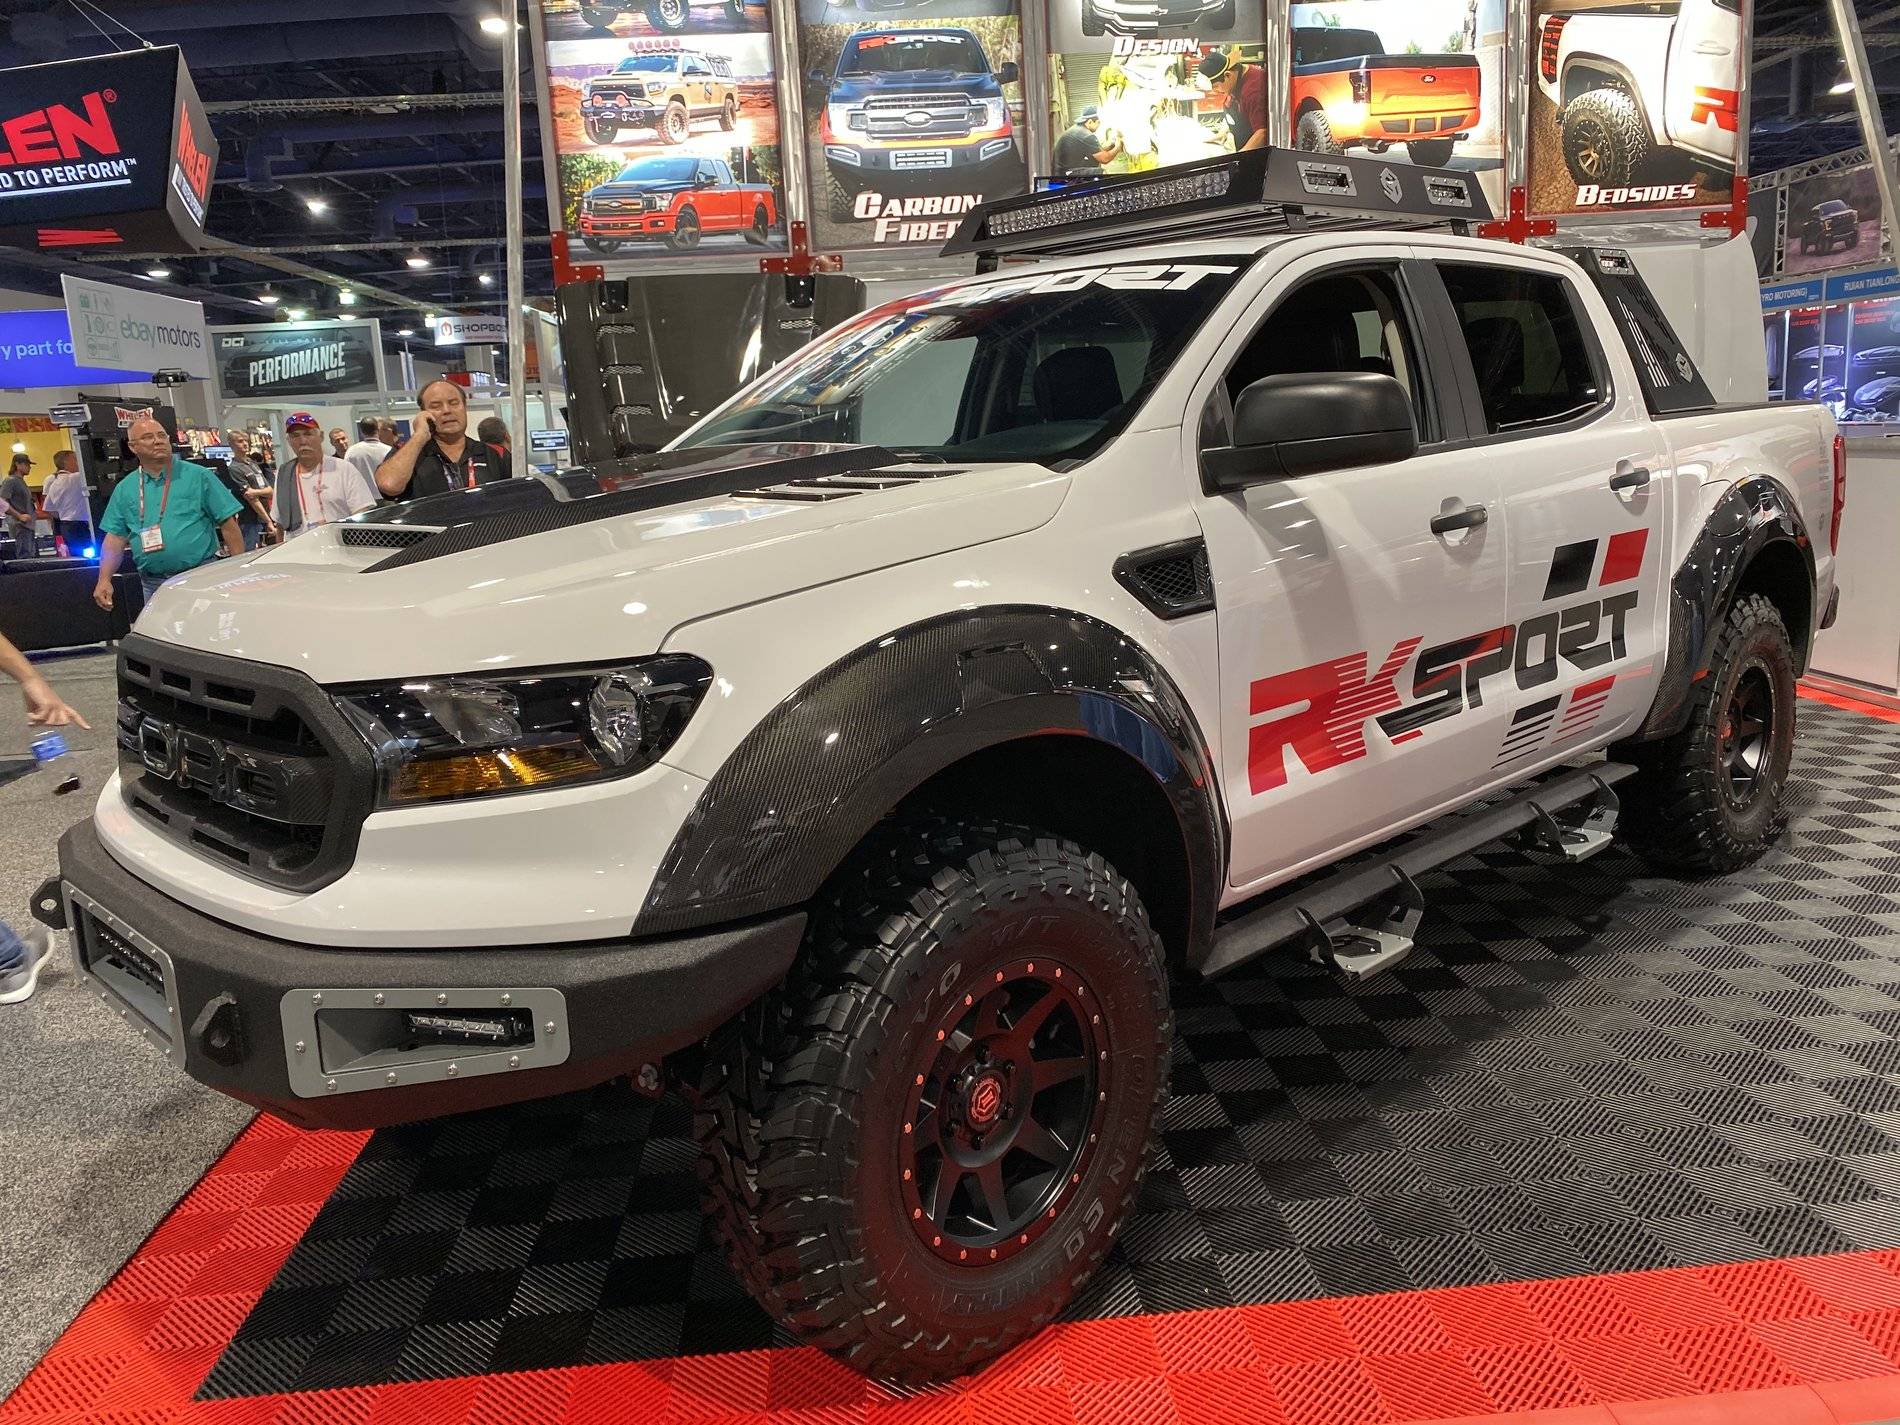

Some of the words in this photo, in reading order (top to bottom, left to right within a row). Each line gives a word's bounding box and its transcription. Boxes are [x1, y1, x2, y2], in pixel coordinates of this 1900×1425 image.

[13, 169, 39, 186] TO
[853, 192, 983, 218] CARBON
[1575, 184, 1697, 206] BEDSIDES
[15, 340, 53, 360] part
[249, 342, 346, 387] PERFORMANCE
